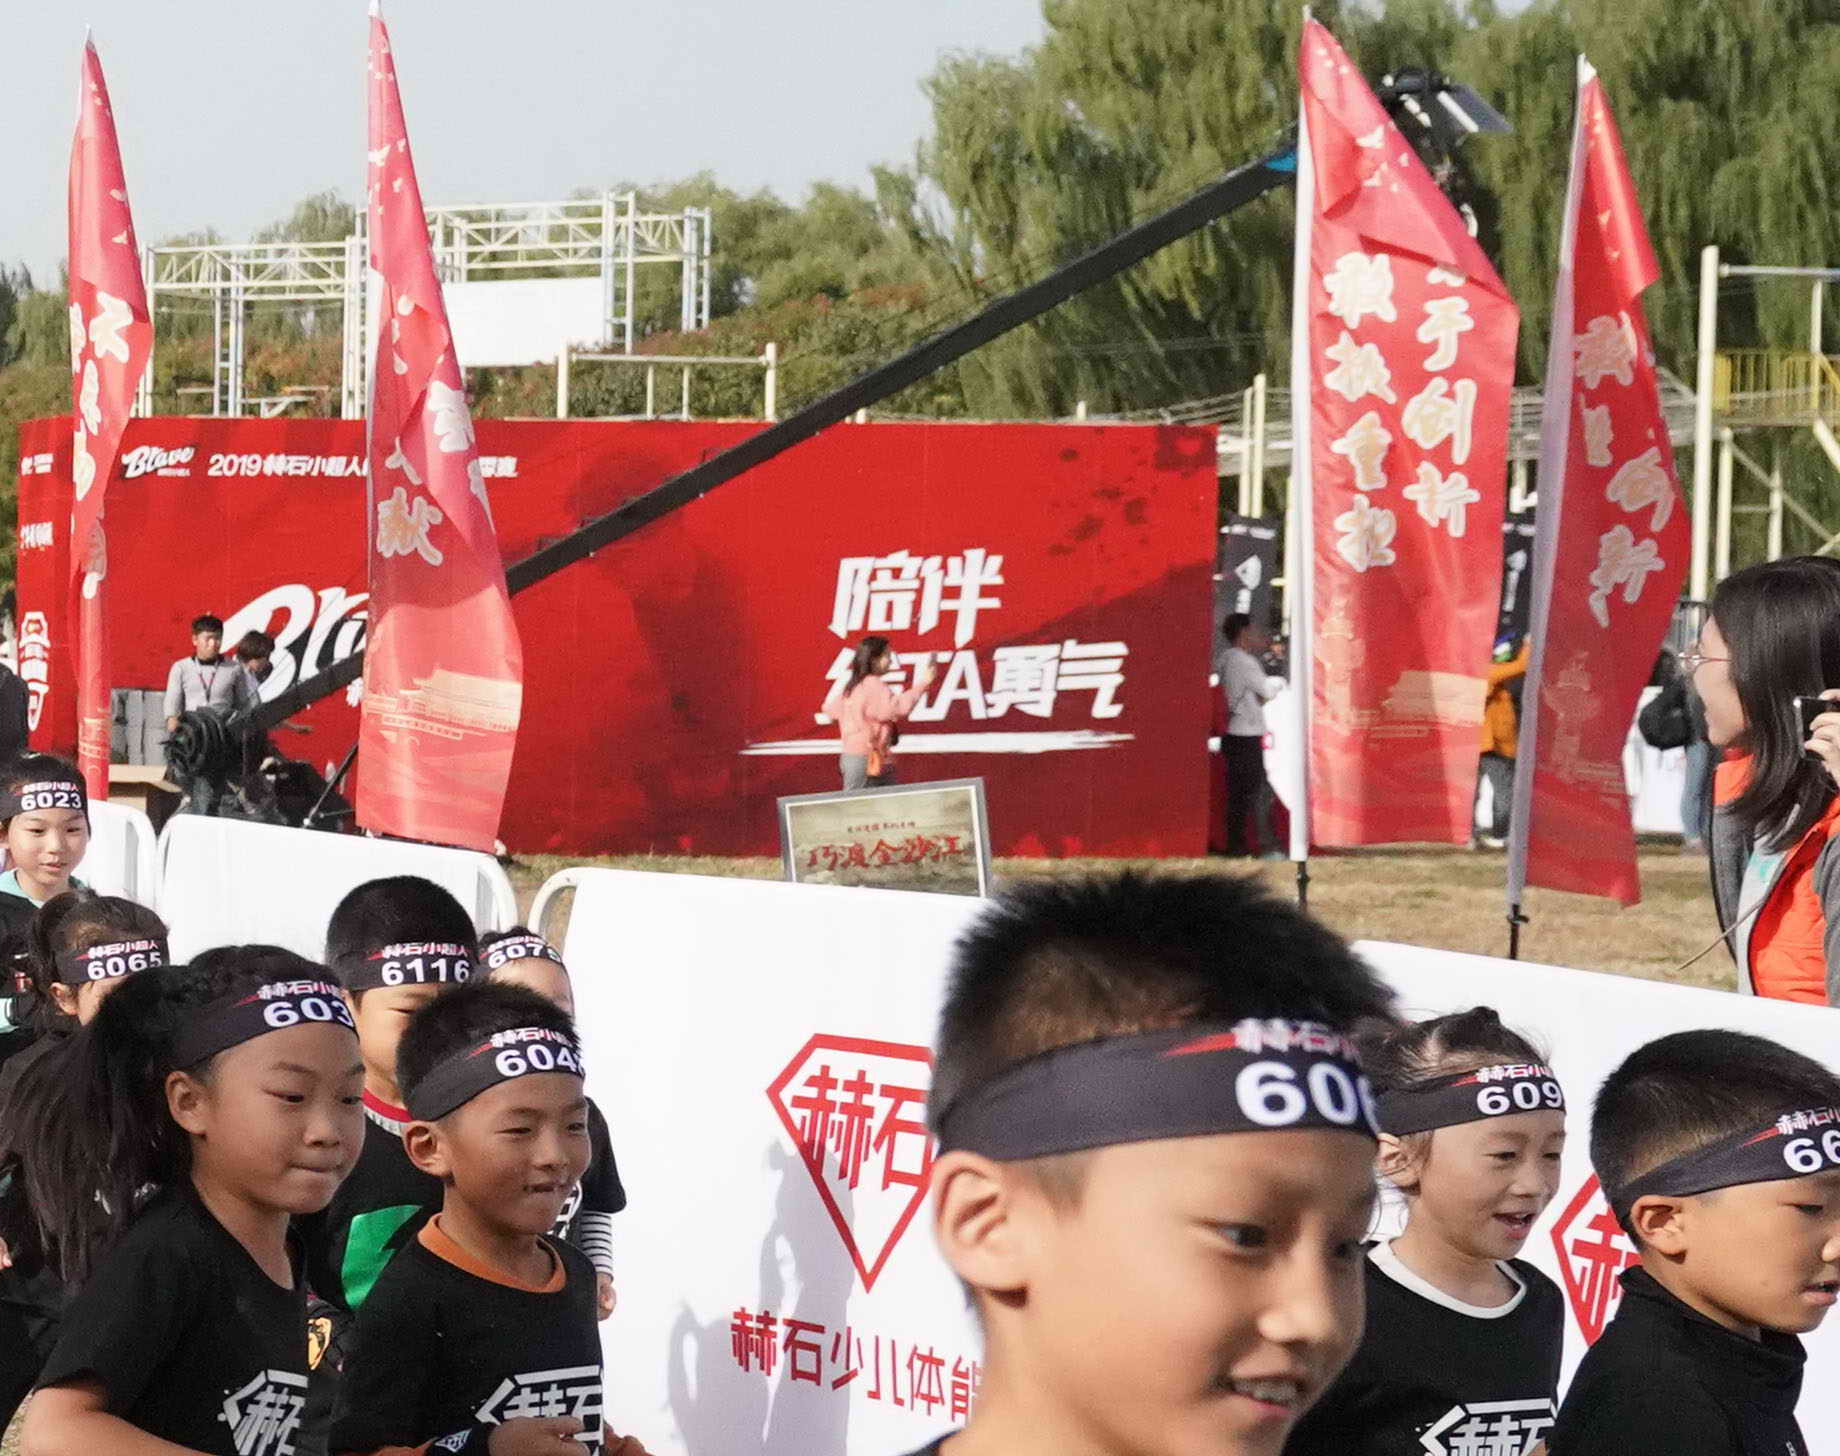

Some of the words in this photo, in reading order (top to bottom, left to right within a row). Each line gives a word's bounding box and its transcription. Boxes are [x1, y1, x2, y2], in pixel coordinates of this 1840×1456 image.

[828, 548, 1004, 649] 陪伴
[21, 793, 81, 811] 6023
[807, 835, 963, 872] 巧渡金沙江
[88, 940, 159, 959] 赫石小超人
[381, 942, 468, 957] 赫石小超人
[87, 951, 162, 980] 6065
[381, 960, 469, 986] 6116
[264, 1000, 354, 1028] 603
[1477, 1081, 1563, 1115] 609
[792, 1066, 932, 1192] 赫石
[1782, 1133, 1840, 1173] 66
